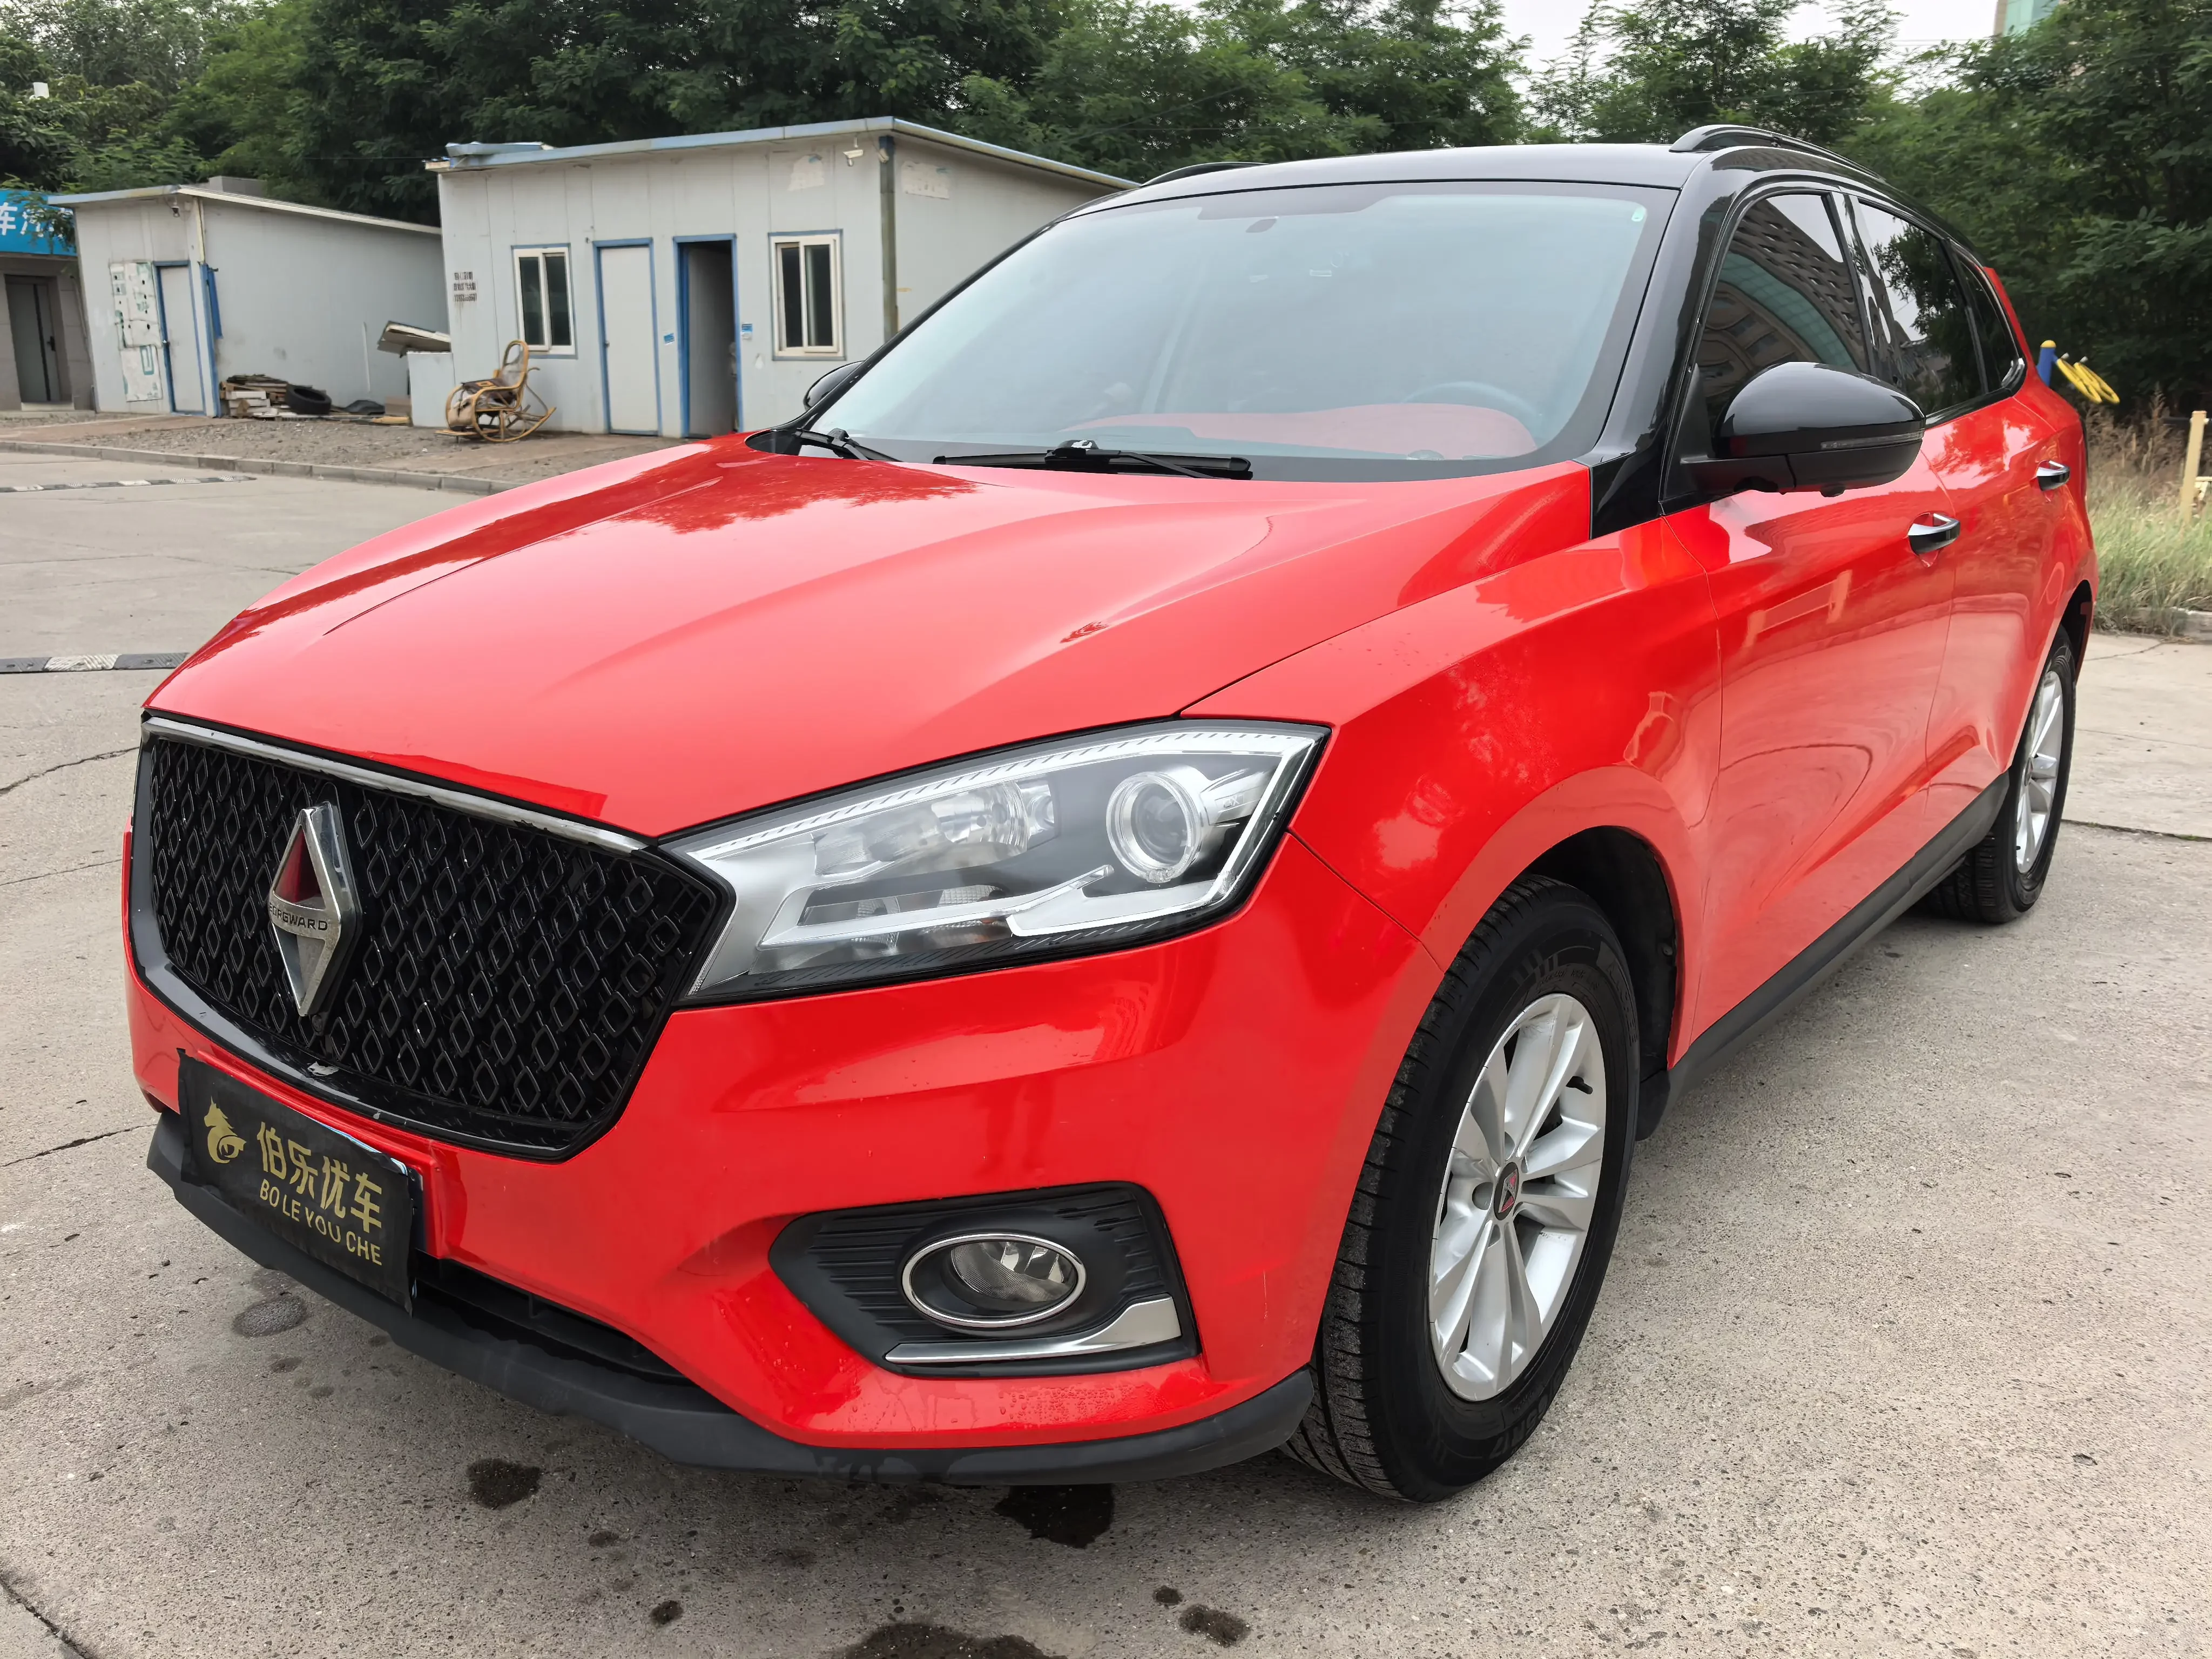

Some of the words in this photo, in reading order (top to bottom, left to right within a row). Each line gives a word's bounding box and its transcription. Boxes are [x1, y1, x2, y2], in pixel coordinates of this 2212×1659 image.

[257, 1122, 382, 1233] 伯乐优车
[305, 1206, 341, 1243] YOU
[346, 1231, 382, 1265] CHE
